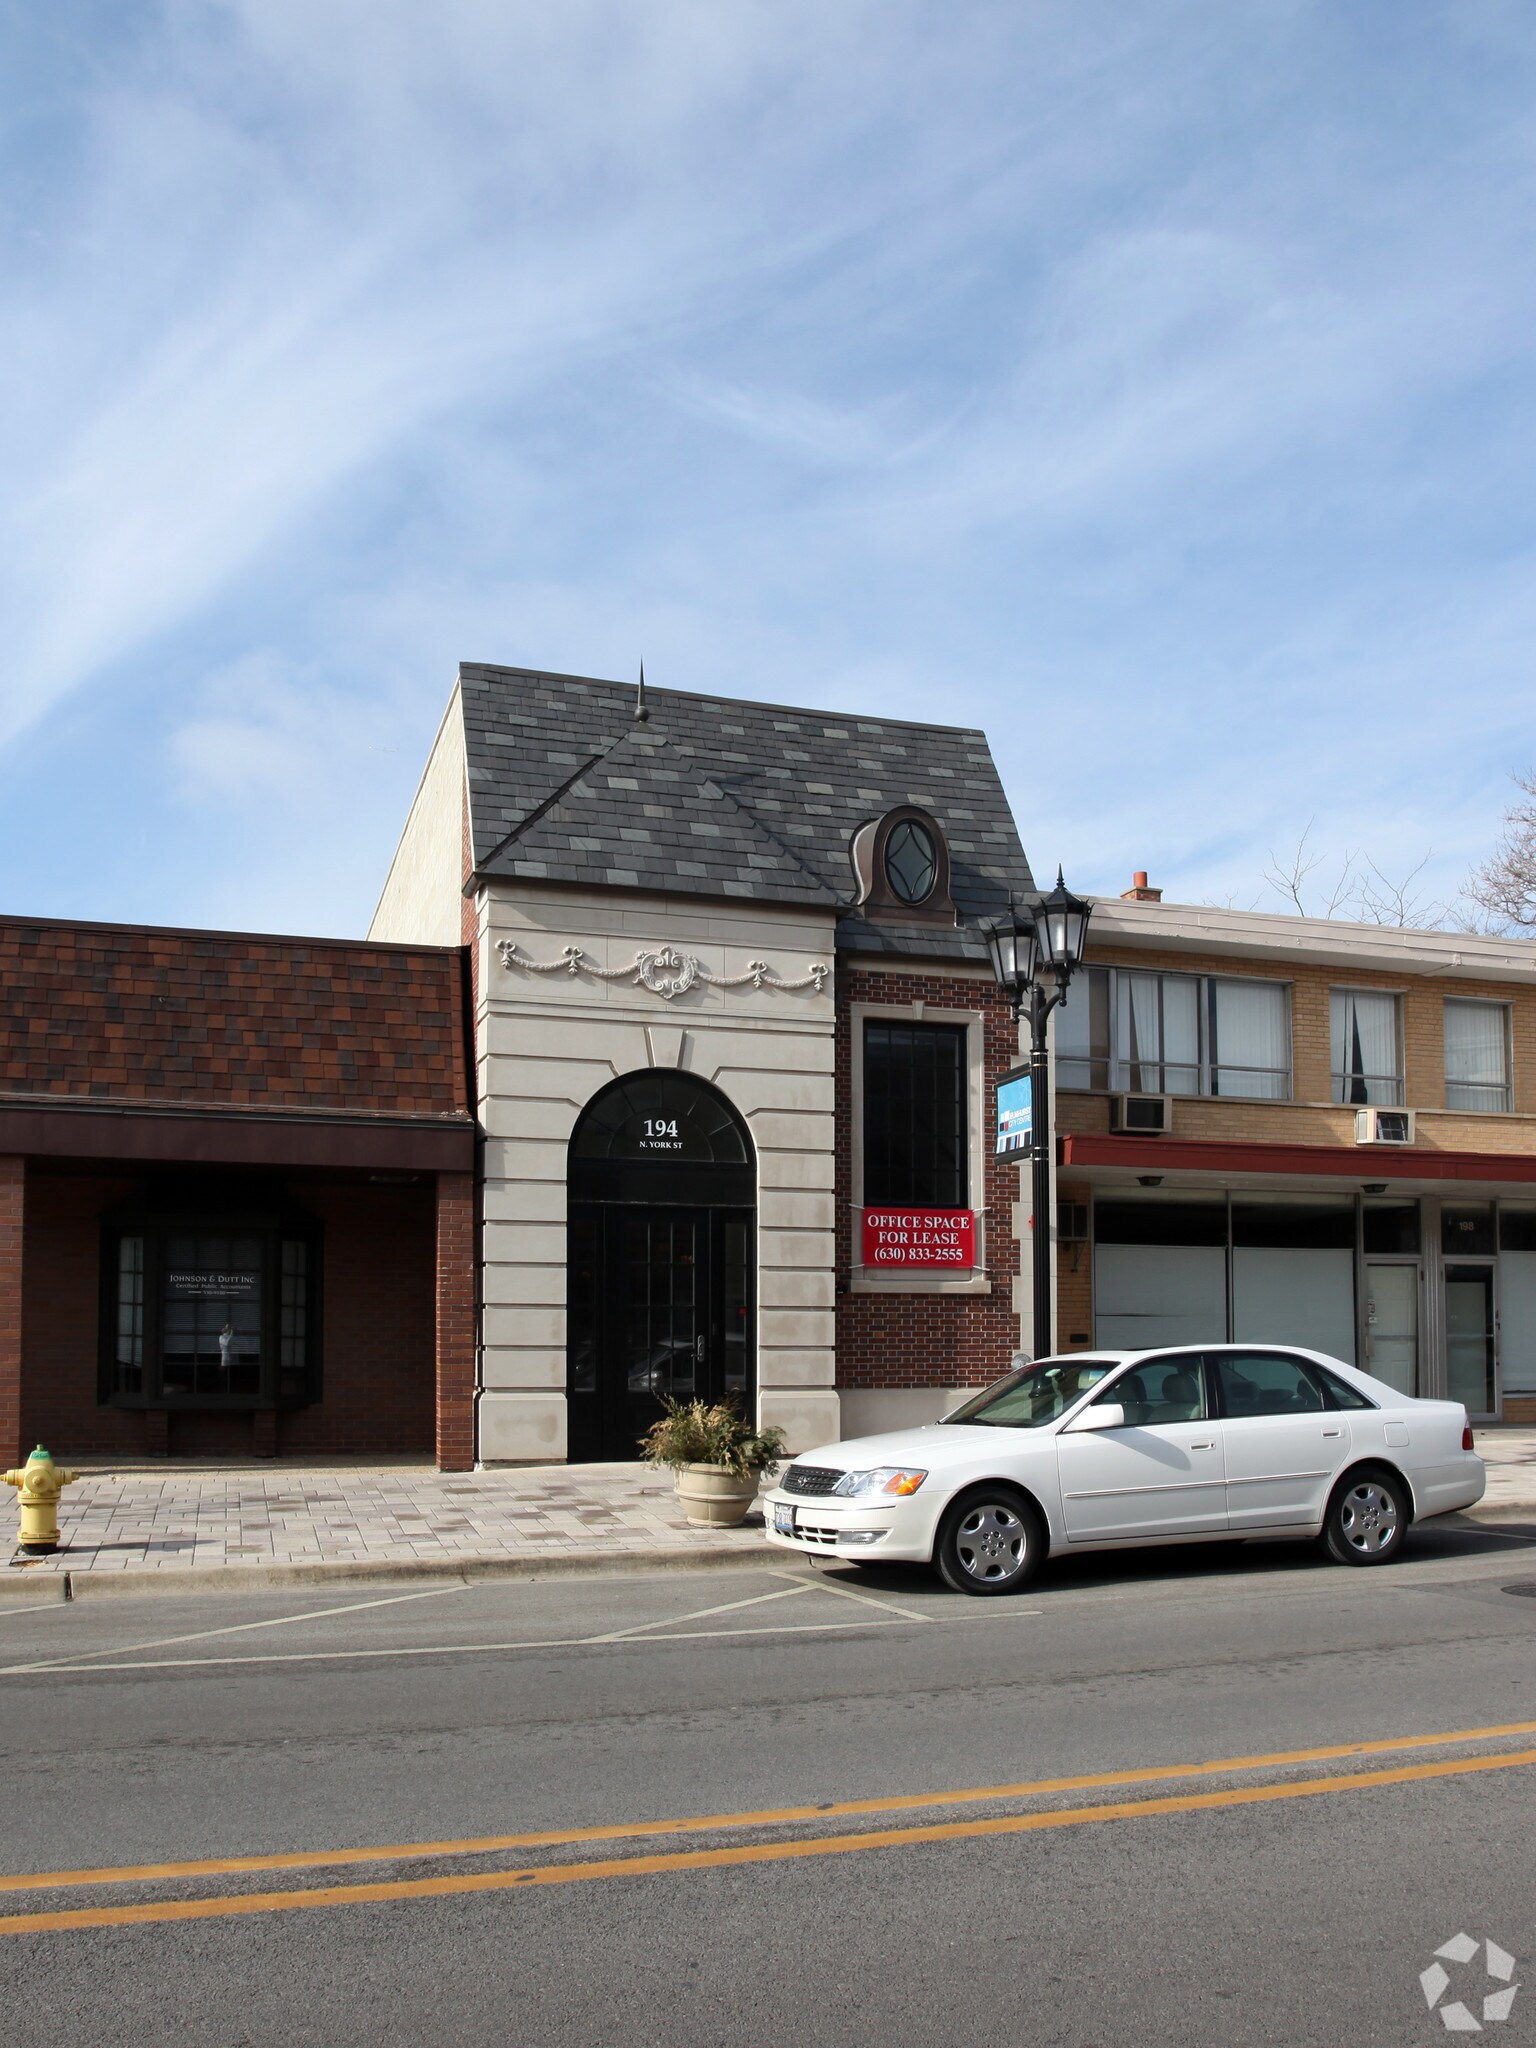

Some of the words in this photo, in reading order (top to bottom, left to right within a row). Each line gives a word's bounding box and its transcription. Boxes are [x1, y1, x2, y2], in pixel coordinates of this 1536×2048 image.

[643, 1119, 678, 1137] 194
[649, 1141, 672, 1149] YORK
[867, 1215, 922, 1229] OFFICE
[924, 1216, 970, 1229] SPACE
[1459, 1221, 1474, 1231] 198
[878, 1231, 909, 1244] FOR
[913, 1232, 959, 1245] LEASE
[874, 1248, 906, 1262] (630)
[909, 1248, 963, 1261] 833-2555
[170, 1274, 207, 1283] JOHNSON
[209, 1275, 215, 1283] &
[218, 1275, 240, 1283] DUTT
